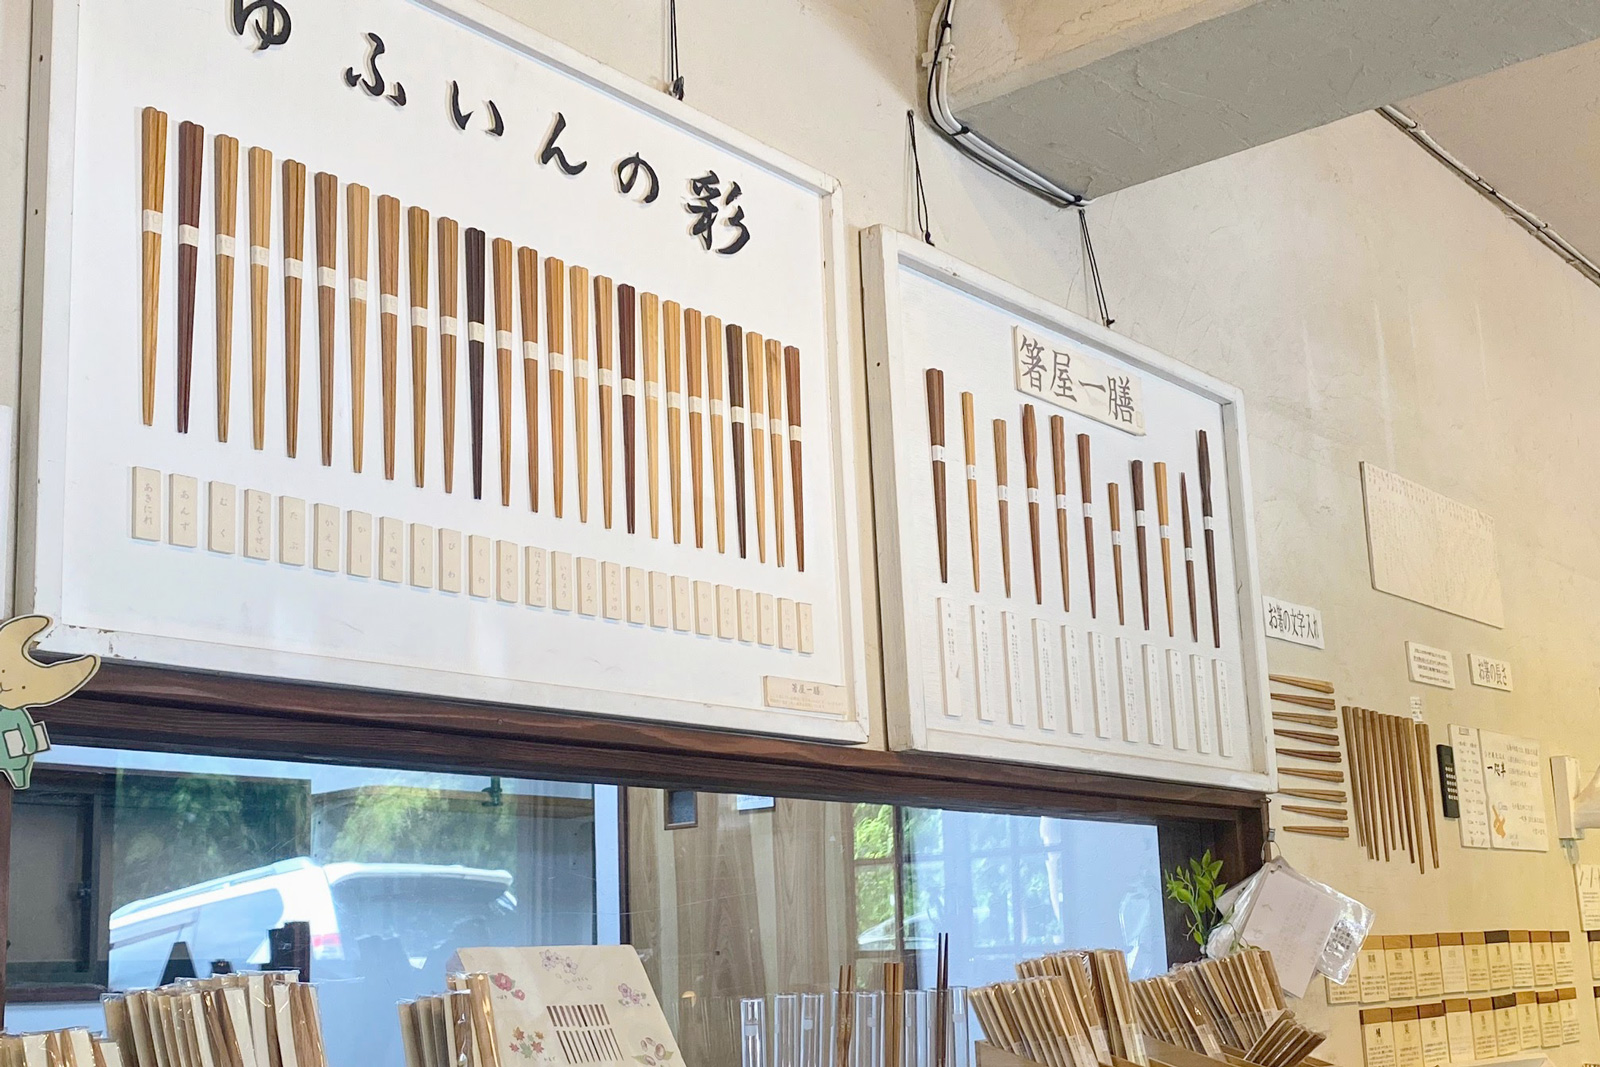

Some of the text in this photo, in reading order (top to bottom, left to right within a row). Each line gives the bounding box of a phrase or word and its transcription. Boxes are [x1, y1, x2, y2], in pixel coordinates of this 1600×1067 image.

[234, 0, 751, 255] ゆふいんの彩
[1020, 334, 1135, 424] 箸屋一膳
[179, 489, 191, 532] あんず
[324, 519, 335, 558] かえで
[1268, 602, 1320, 640] お箸の文字入れ
[791, 682, 821, 696] 箸屋一膳
[1477, 658, 1508, 687] お箸の長さ
